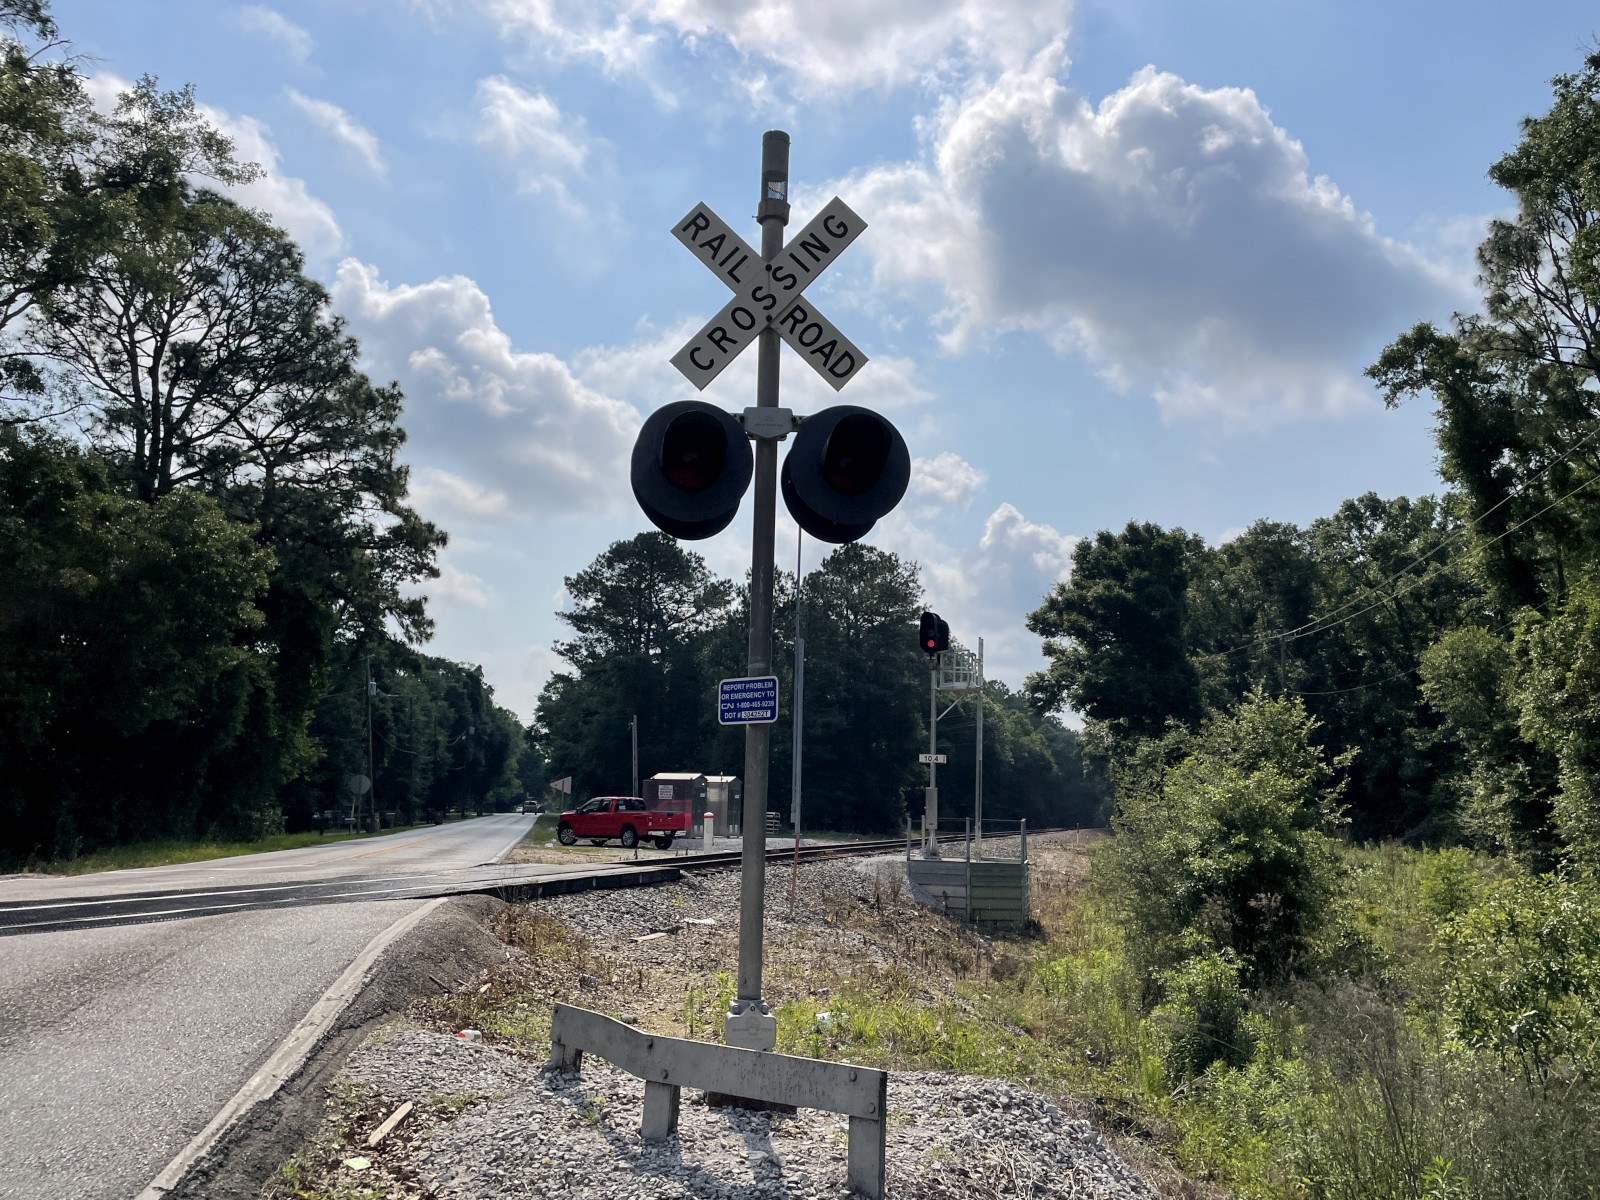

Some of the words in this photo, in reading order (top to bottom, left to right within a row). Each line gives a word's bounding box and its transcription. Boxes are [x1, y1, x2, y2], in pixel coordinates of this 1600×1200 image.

[682, 211, 748, 284] RAIL
[689, 214, 849, 371] CROSSING
[779, 304, 856, 379] ROAD
[730, 691, 766, 700] EMERGENCY
[746, 682, 773, 690] PROBLEM
